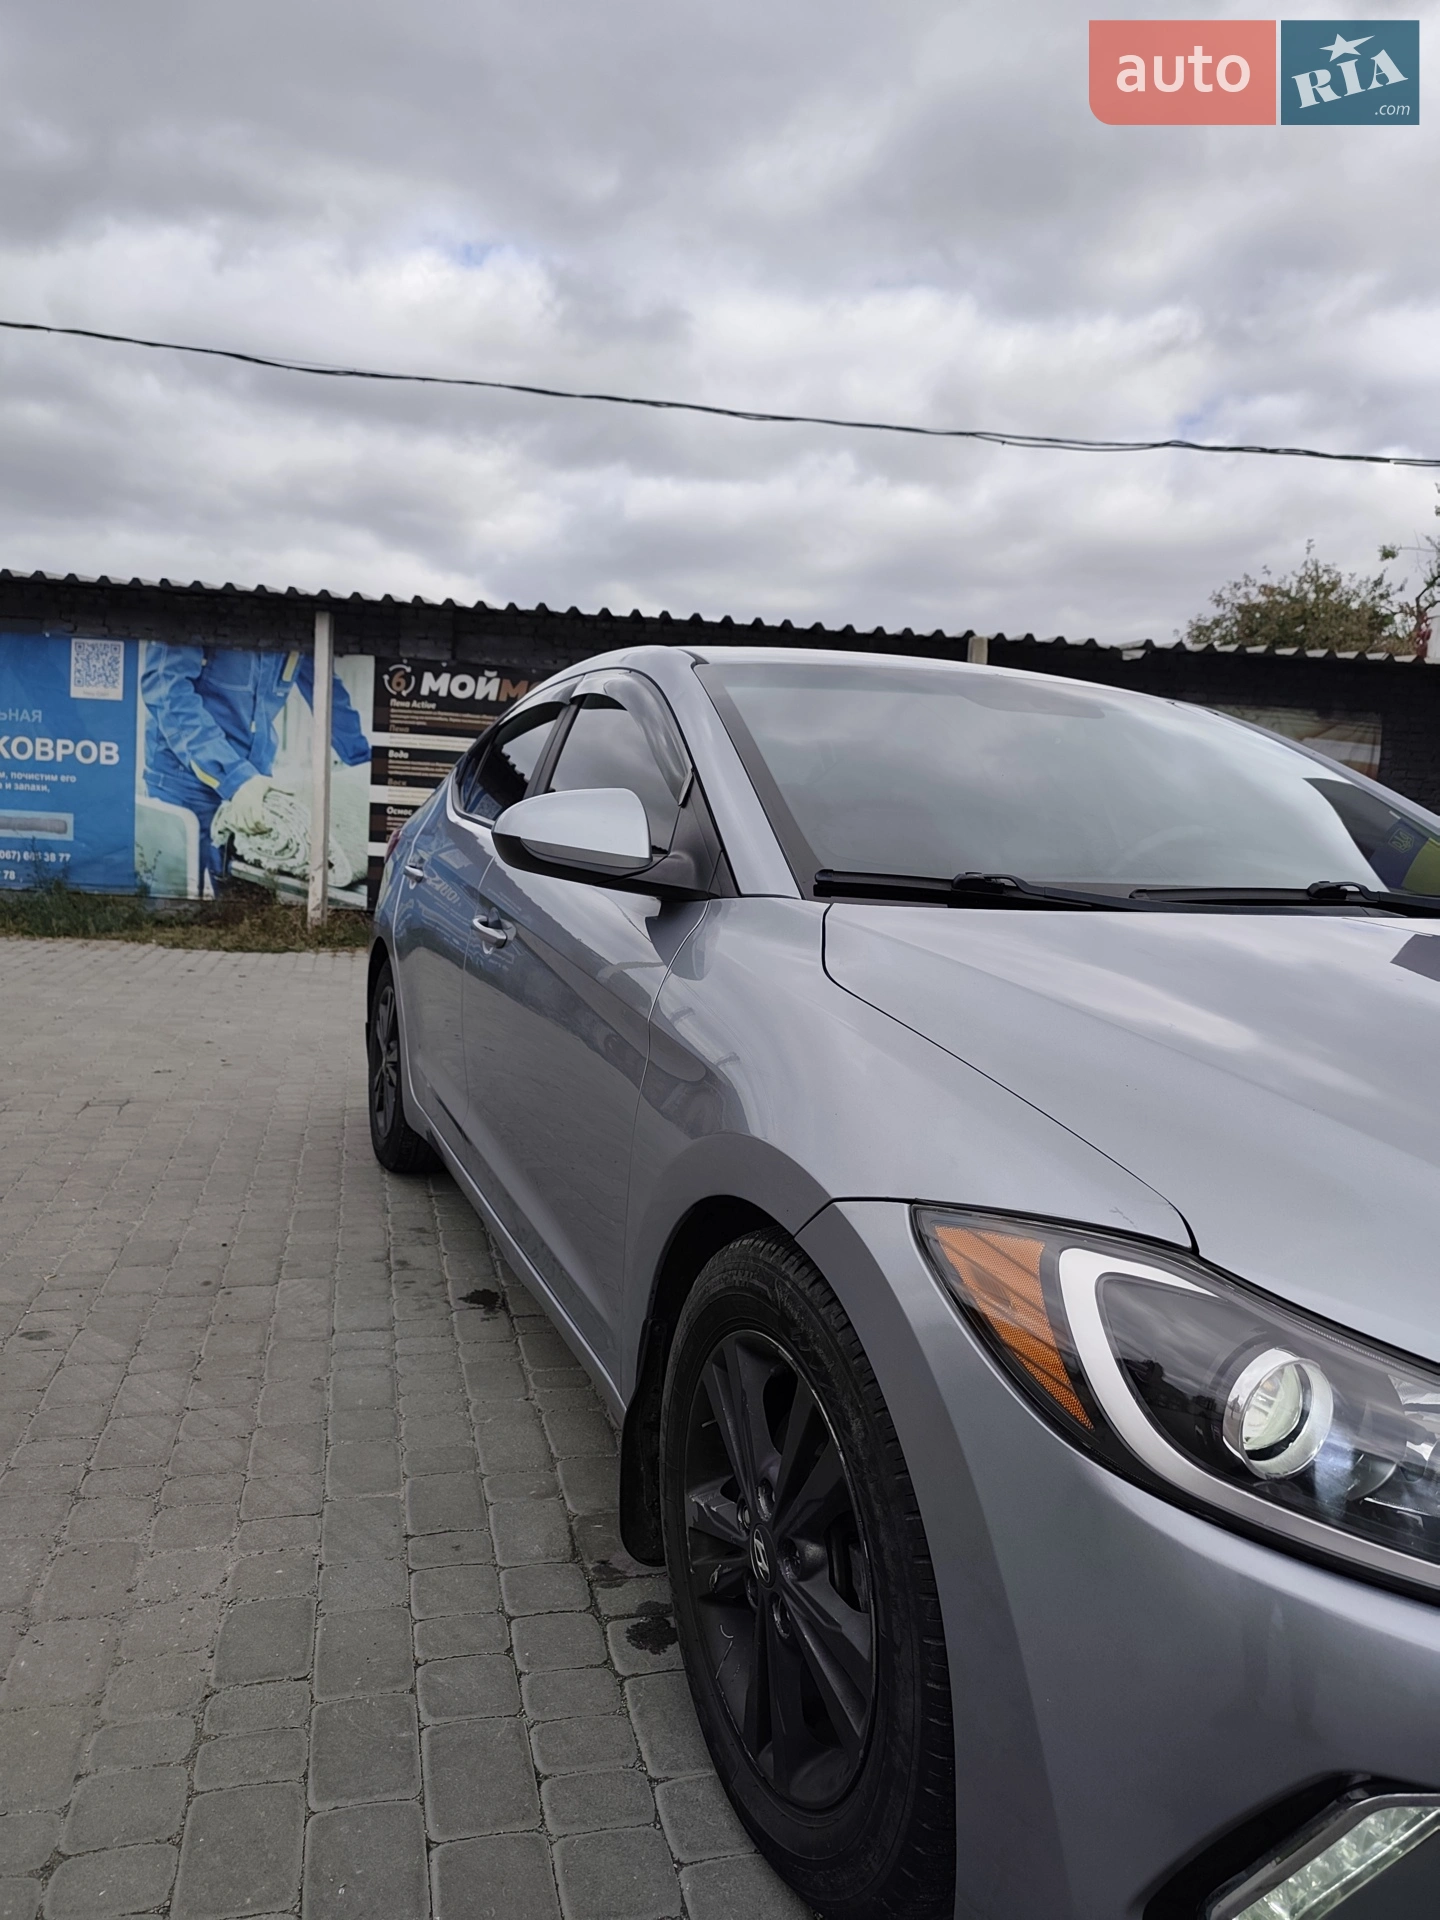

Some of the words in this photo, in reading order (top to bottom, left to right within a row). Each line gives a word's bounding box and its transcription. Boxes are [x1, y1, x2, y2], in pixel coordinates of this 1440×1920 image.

[389, 699, 411, 708] Пена
[411, 700, 437, 710] Active
[388, 749, 409, 759] Вода
[11, 771, 58, 782] почистим
[60, 774, 77, 783] его
[59, 852, 71, 863] 77
[3, 869, 16, 880] 78
